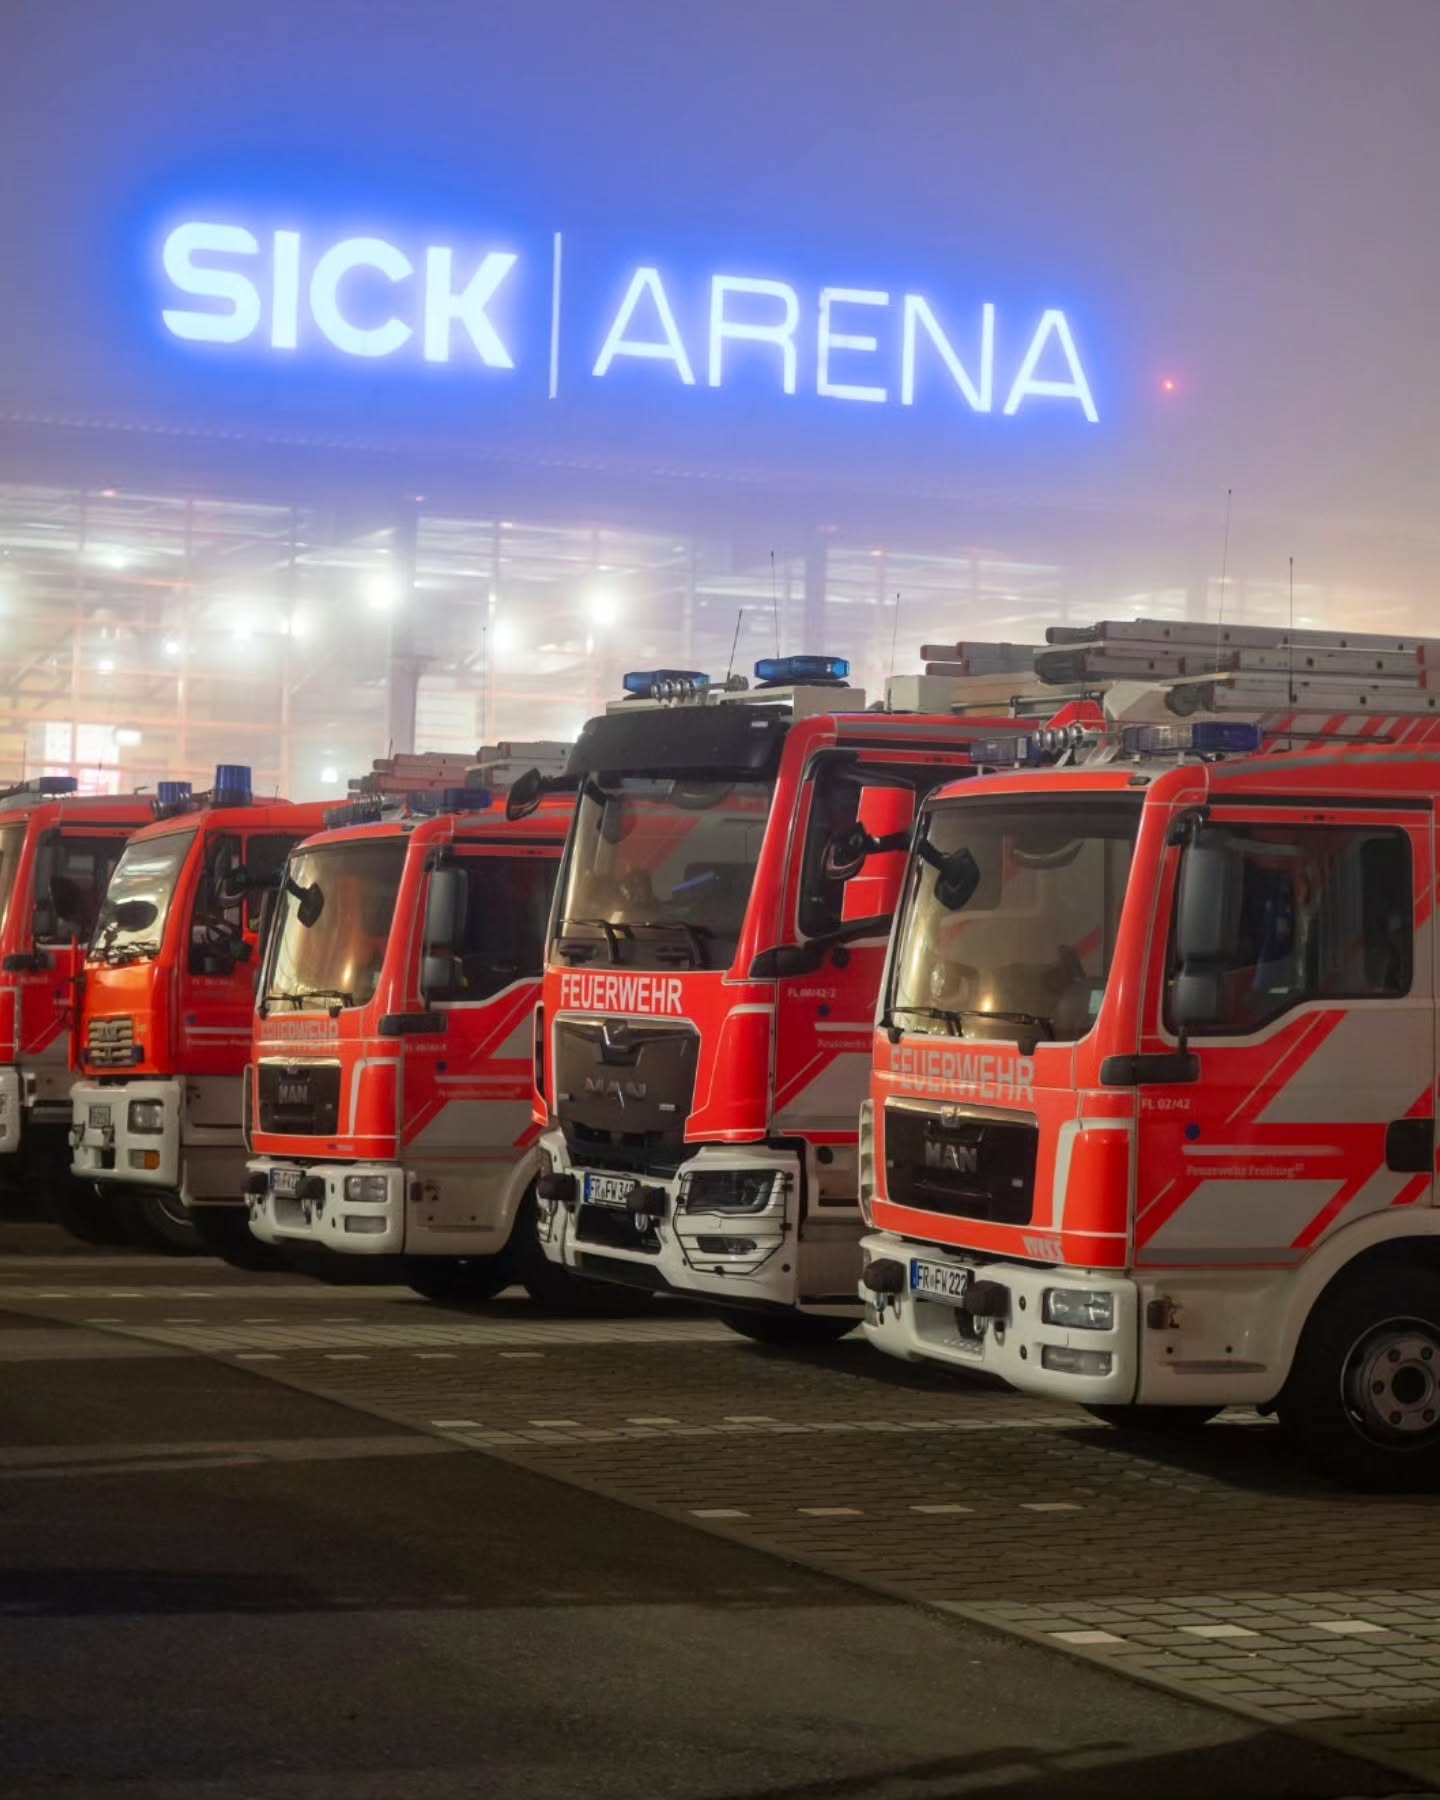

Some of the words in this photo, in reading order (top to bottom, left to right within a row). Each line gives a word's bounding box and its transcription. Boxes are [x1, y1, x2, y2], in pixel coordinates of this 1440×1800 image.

[162, 221, 519, 369] SICK
[591, 266, 1100, 424] ARENA
[560, 973, 684, 1015] FEUERWEHR
[889, 1045, 1036, 1104] FEUERWEHR
[1141, 1098, 1155, 1110] FL
[1157, 1098, 1191, 1111] 02/42
[924, 1139, 978, 1174] MAN
[917, 1264, 930, 1290] FR
